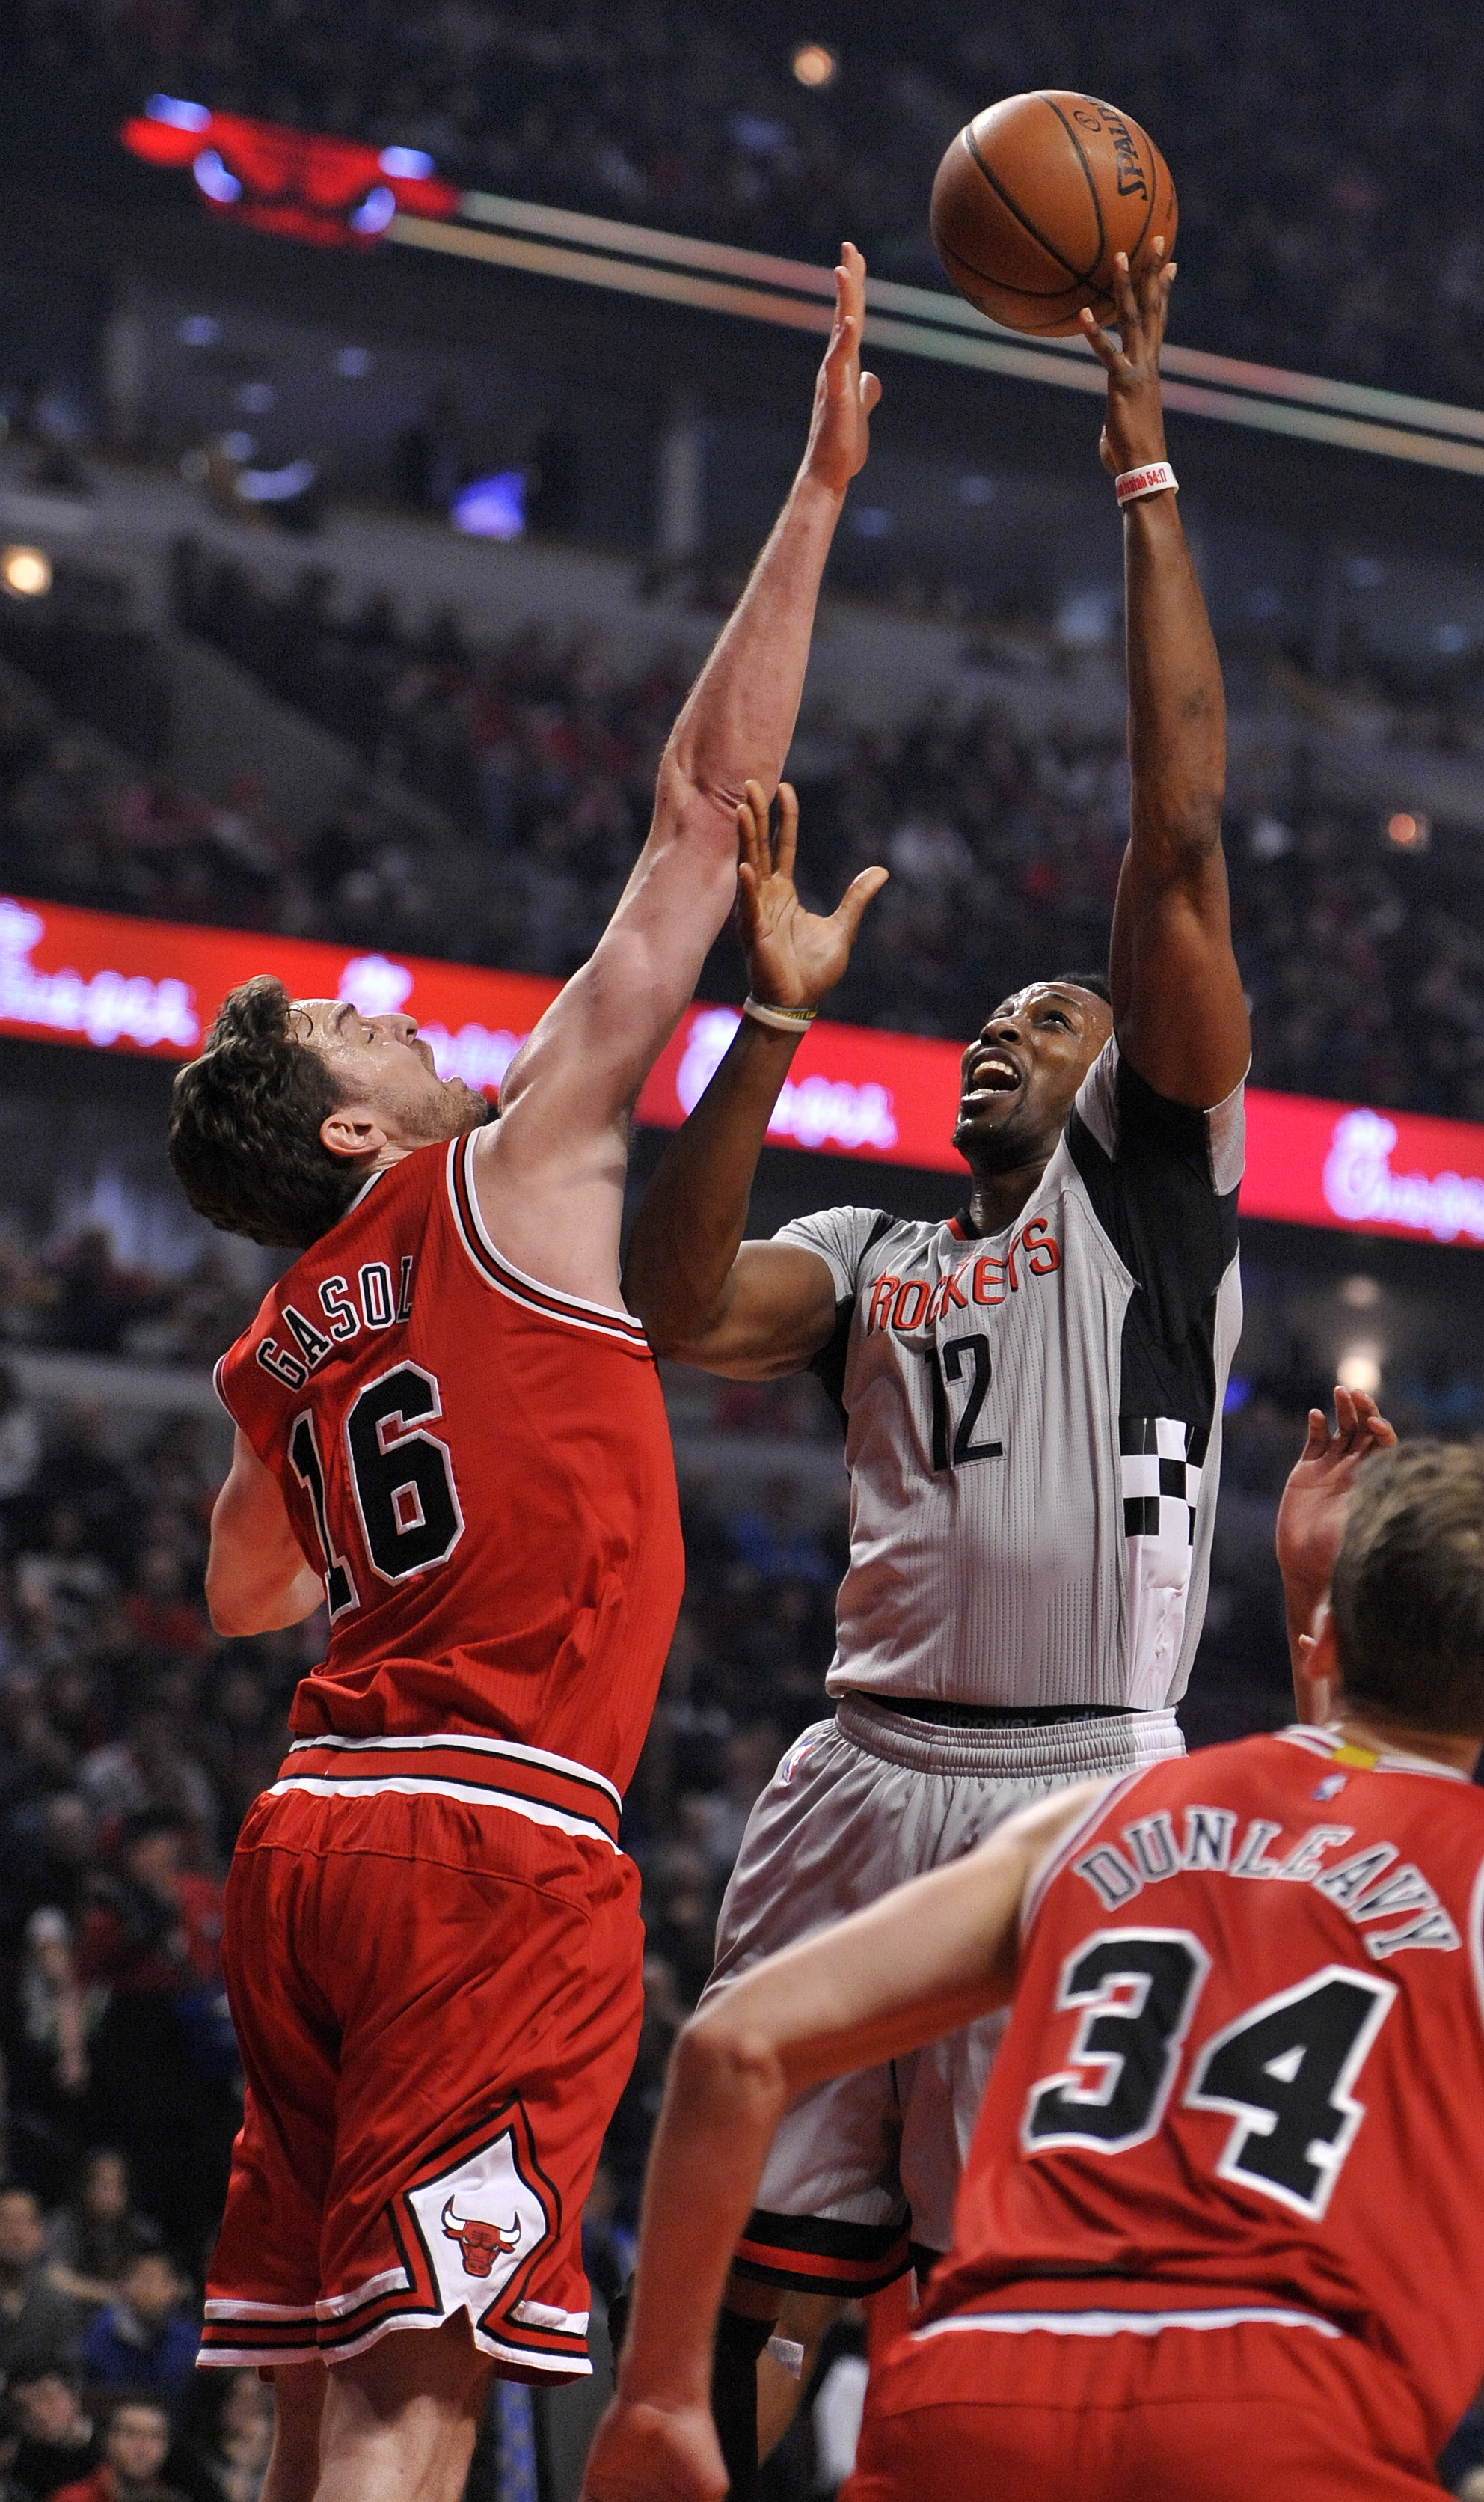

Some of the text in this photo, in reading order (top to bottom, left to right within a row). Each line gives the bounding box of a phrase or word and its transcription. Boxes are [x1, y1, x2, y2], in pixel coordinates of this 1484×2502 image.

[255, 1255, 414, 1393] GASOL
[924, 1332, 1007, 1472] 12
[287, 1359, 466, 1624] 16
[1072, 1804, 1462, 1960] DUNLEAVY
[1020, 1926, 1399, 2222] 34
